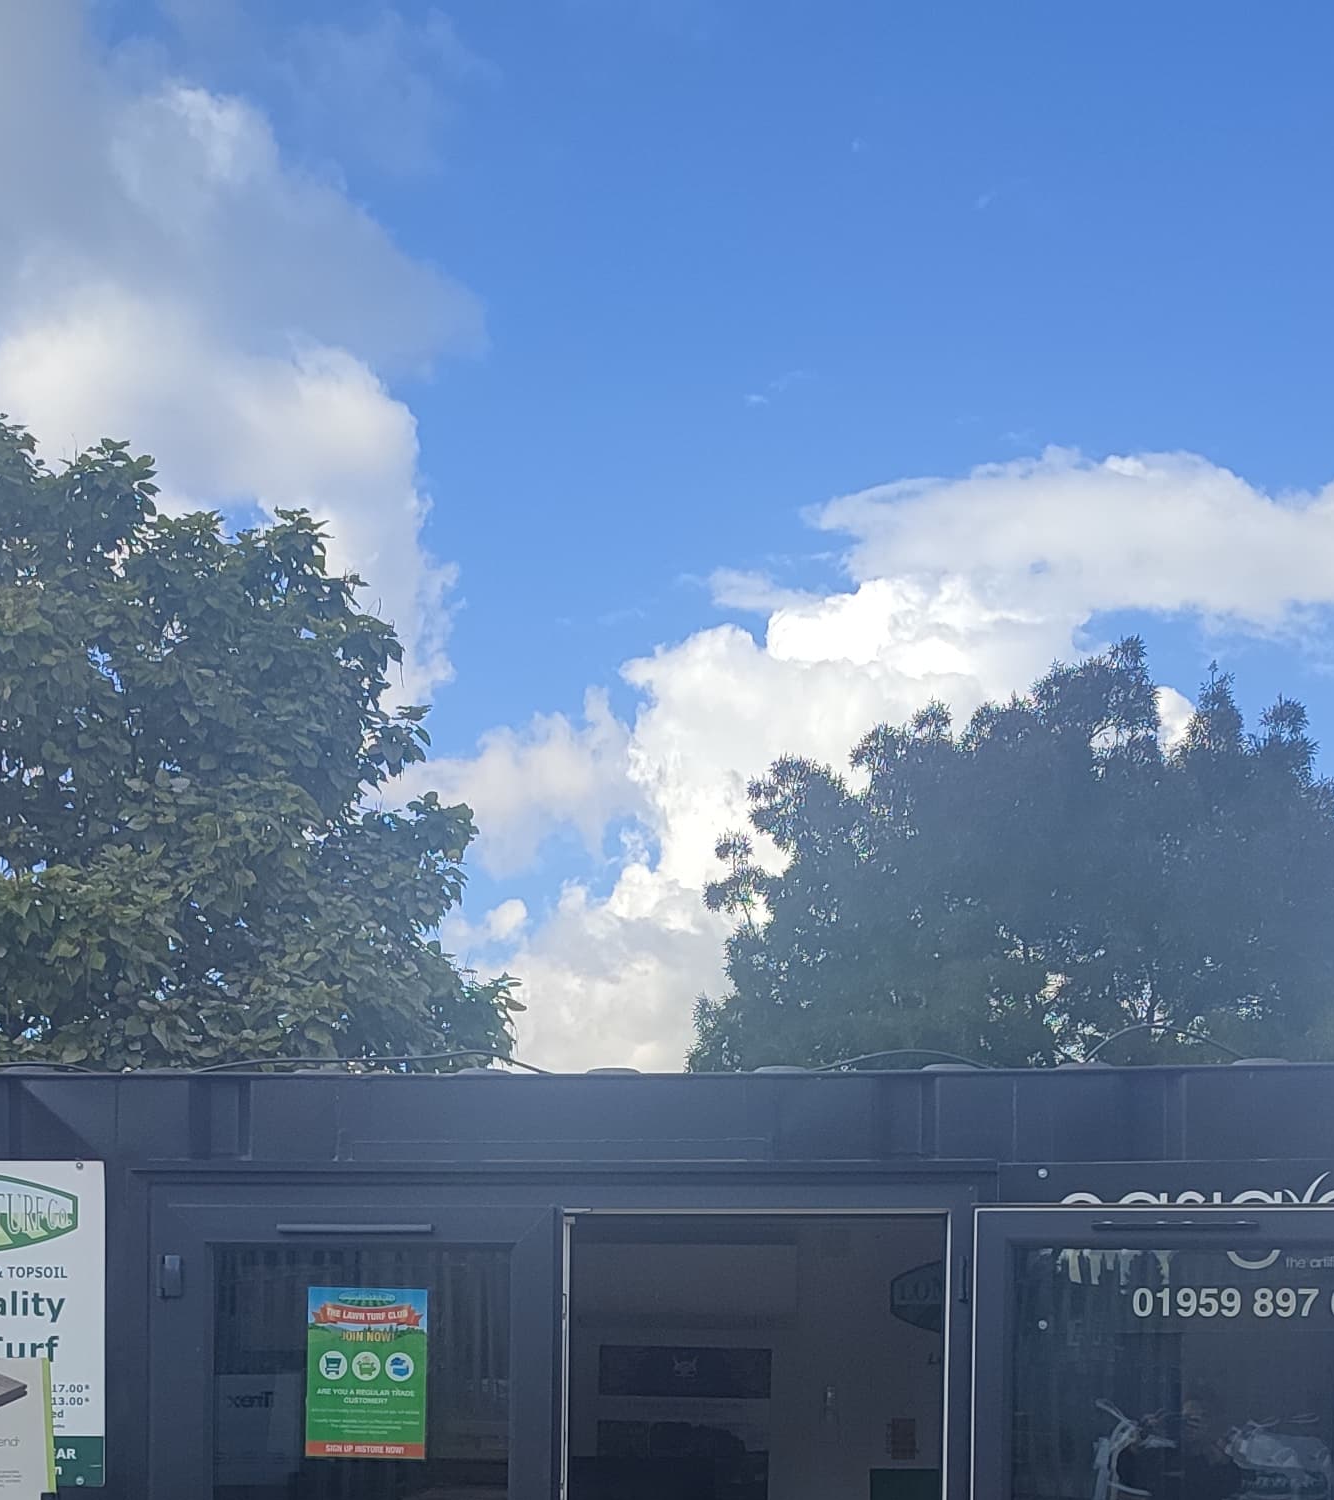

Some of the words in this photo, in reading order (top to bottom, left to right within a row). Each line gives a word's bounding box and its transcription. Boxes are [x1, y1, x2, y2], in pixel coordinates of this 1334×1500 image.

[9, 1267, 67, 1279] TOPSOIL
[1133, 1288, 1242, 1317] 01959
[1253, 1288, 1319, 1317] 897
[327, 1308, 340, 1318] THE
[343, 1311, 364, 1320] LAWN
[366, 1310, 386, 1320] TURF
[388, 1309, 408, 1319] CLUB
[342, 1331, 364, 1341] JOIN
[367, 1331, 395, 1342] NOW!
[392, 1389, 415, 1397] TRADE
[326, 1444, 343, 1452] SIGN
[344, 1445, 353, 1453] UP
